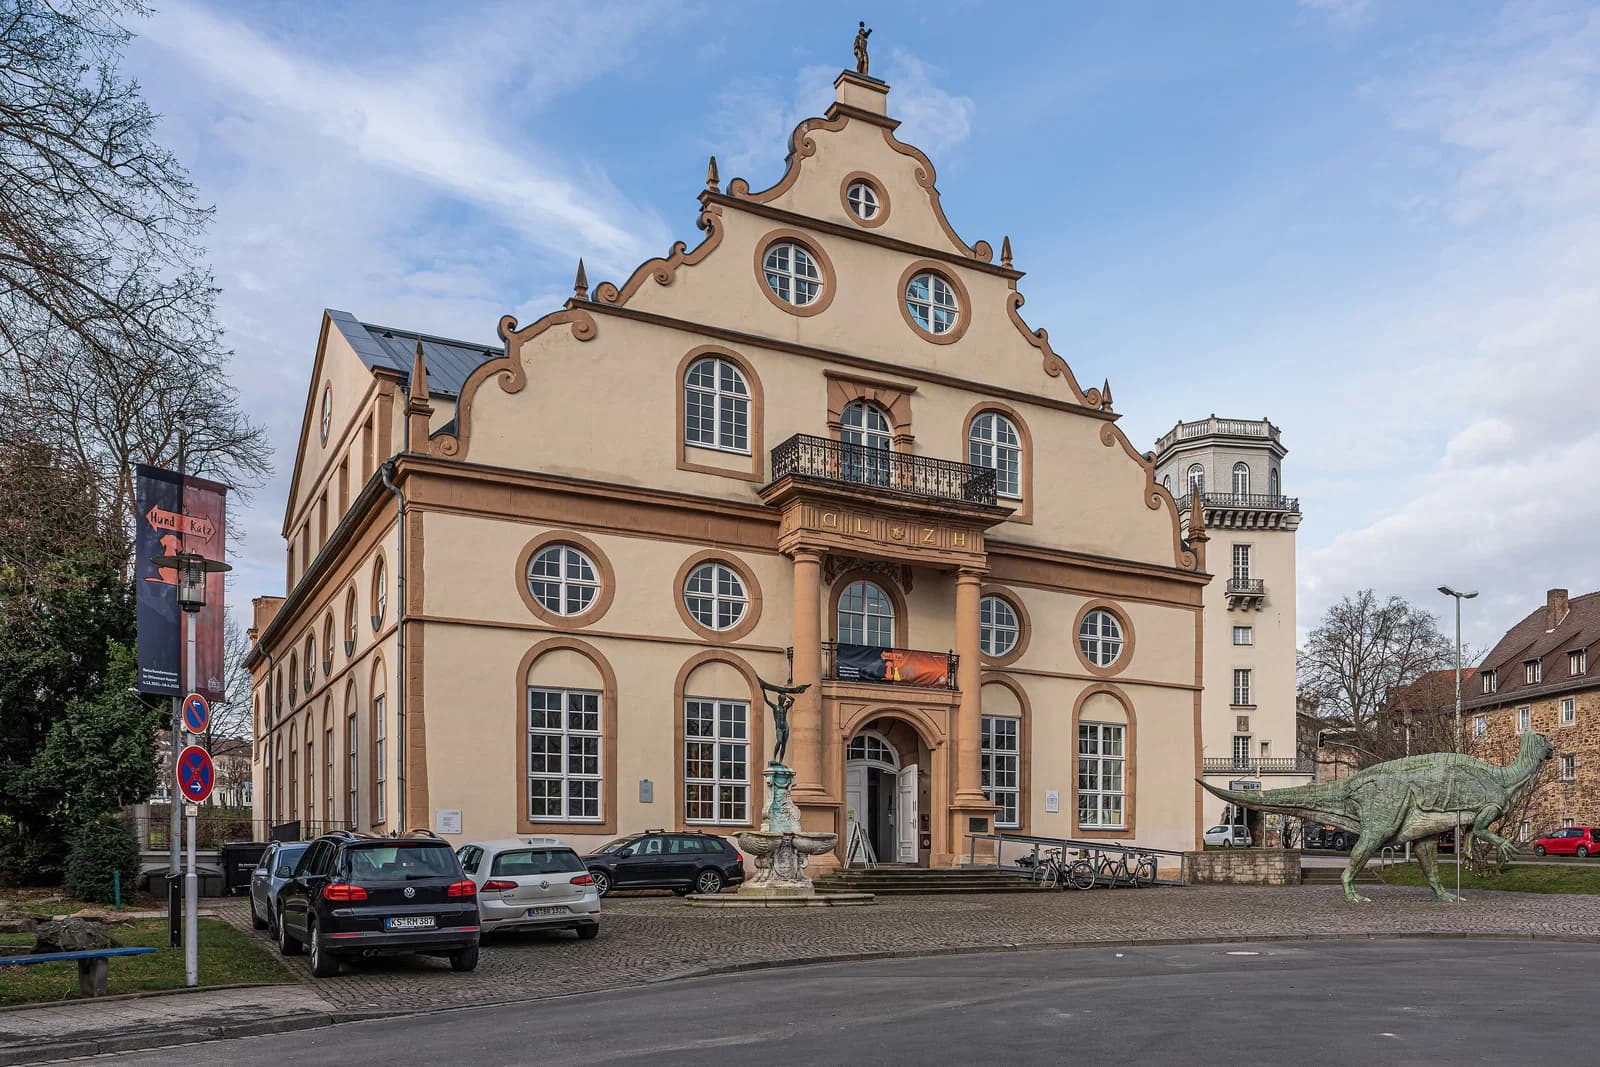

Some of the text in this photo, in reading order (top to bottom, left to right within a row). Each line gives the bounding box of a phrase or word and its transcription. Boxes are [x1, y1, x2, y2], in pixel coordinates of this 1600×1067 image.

[151, 511, 175, 527] Hund
[857, 518, 869, 533] L
[922, 528, 936, 544] Z
[954, 532, 965, 545] H
[391, 918, 402, 927] KS
